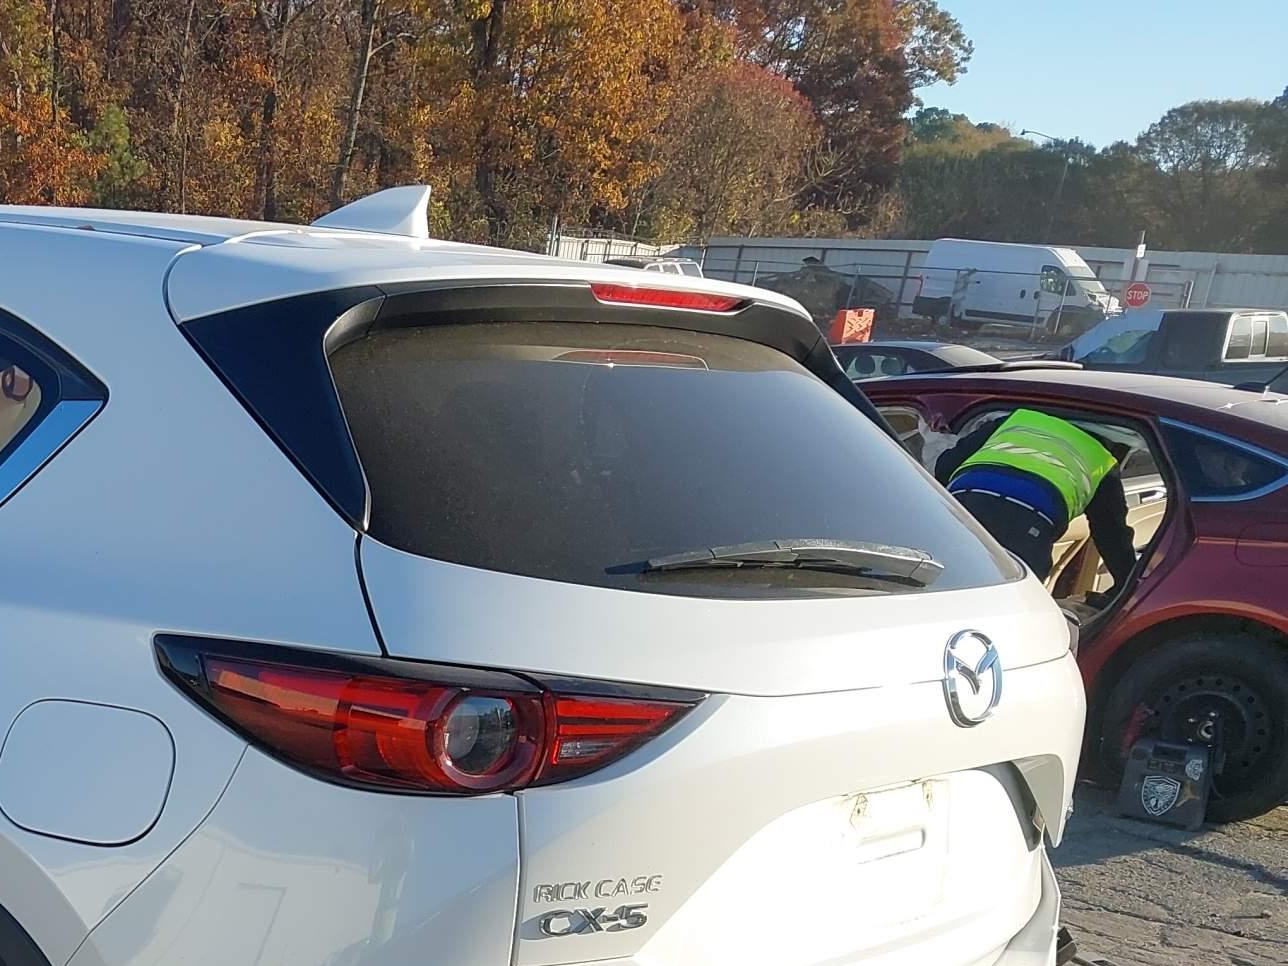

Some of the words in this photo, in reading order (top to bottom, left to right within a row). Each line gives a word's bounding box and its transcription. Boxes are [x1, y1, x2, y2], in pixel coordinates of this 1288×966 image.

[1127, 290, 1149, 300] STOP
[533, 881, 591, 903] RICK
[595, 874, 663, 898] CASE
[539, 903, 649, 937] CX-5
